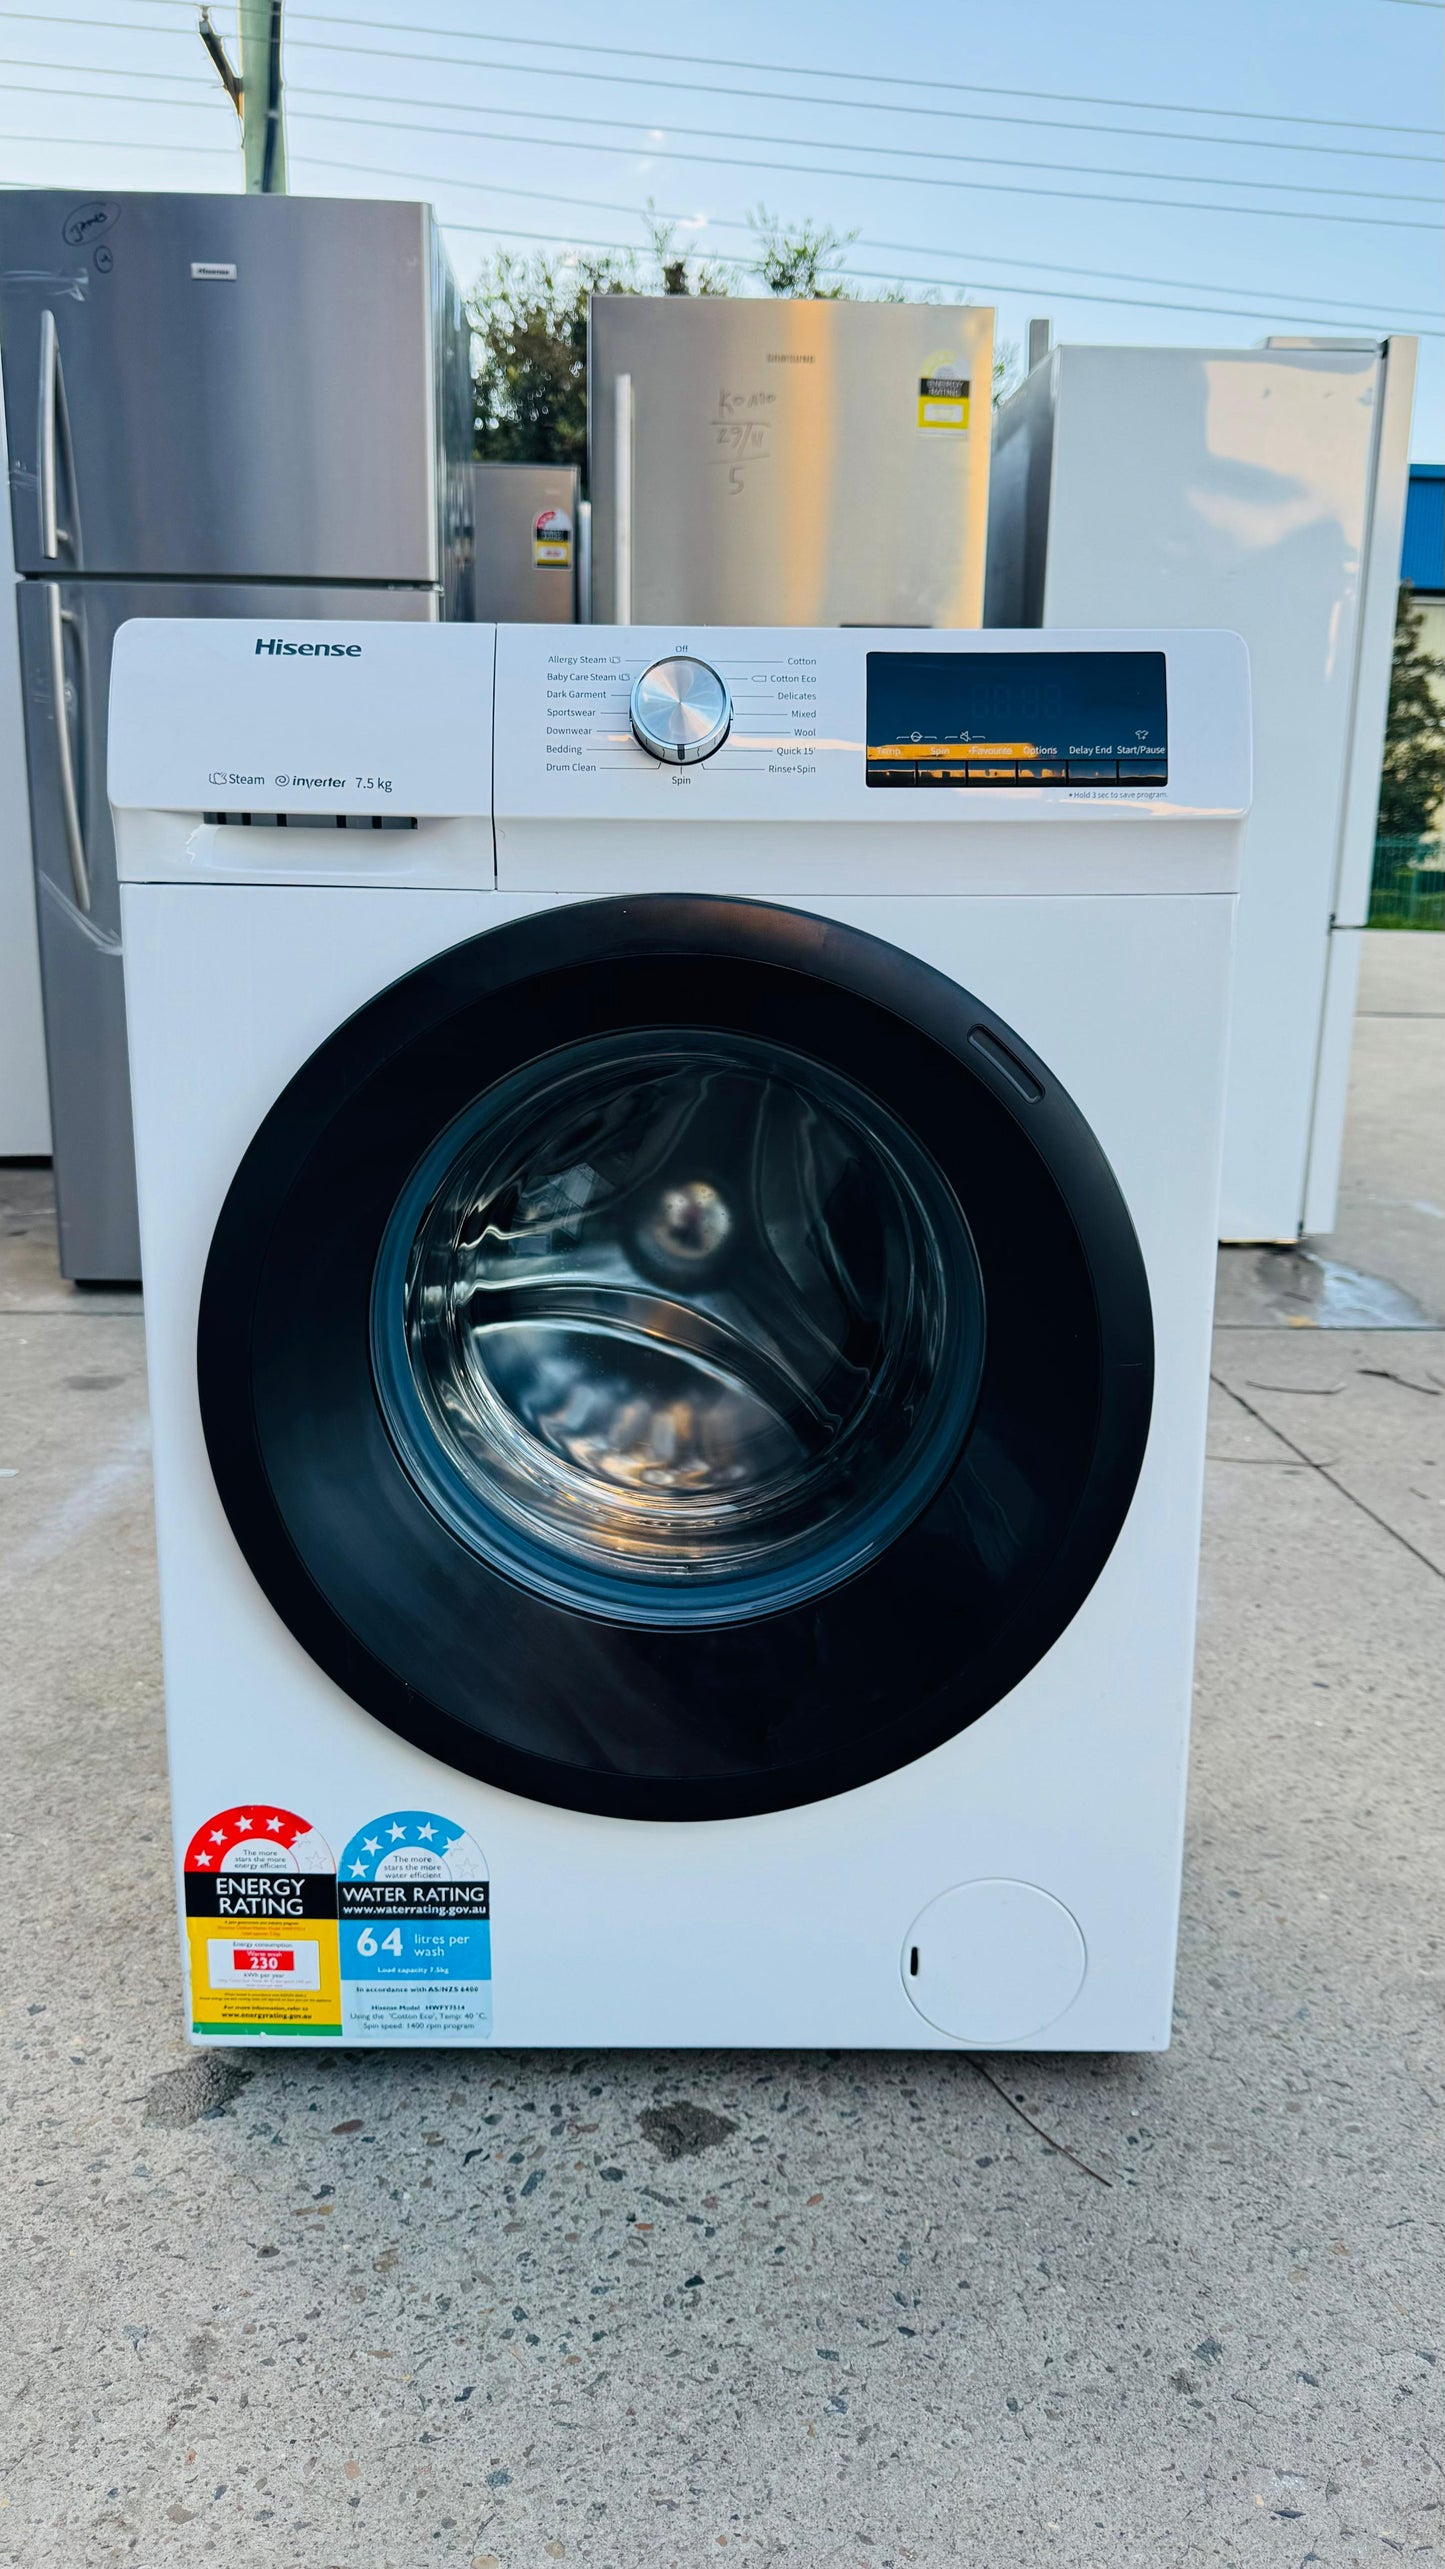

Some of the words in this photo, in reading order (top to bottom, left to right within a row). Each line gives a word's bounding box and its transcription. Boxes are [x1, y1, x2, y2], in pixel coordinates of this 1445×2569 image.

[729, 466, 745, 496] 5
[255, 638, 362, 657] Hisense
[675, 645, 689, 653] Off
[548, 656, 578, 665] Allergy
[580, 656, 607, 664] Steam
[787, 657, 817, 665] Cotton
[547, 673, 569, 682] Baby
[569, 673, 589, 681] Care
[590, 673, 617, 681] Steam
[770, 675, 799, 683] Cotton
[801, 675, 817, 683] Eco
[546, 690, 567, 698] Dark
[568, 690, 607, 699] Garment
[777, 692, 817, 700] Delicates
[547, 708, 596, 717] Sportswear
[791, 710, 817, 718] Mixed
[546, 726, 593, 735] Downwear
[794, 728, 816, 737] Wool
[546, 744, 583, 755] Bedding
[776, 746, 802, 756] Quick
[930, 747, 950, 757] Spin
[1023, 746, 1058, 757] Options
[1069, 745, 1094, 757] Delay
[1095, 745, 1112, 754] End
[1116, 745, 1166, 755] Start/Pause
[546, 763, 571, 772] Drum
[572, 763, 597, 772] Clean
[768, 764, 816, 775] Rinse+Spin
[228, 773, 265, 785] Steam
[292, 775, 346, 789] inverter
[355, 777, 375, 789] 7.5
[377, 777, 393, 793] kg
[671, 775, 691, 786] Spin
[393, 1855, 409, 1863] The
[216, 1877, 306, 1896] ENERGY
[343, 1887, 407, 1902] WATER
[413, 1887, 485, 1903] RATING
[219, 1897, 304, 1916] RATING
[343, 1904, 487, 1916] www.waterrating.gov.au
[233, 1941, 253, 1949] Energy
[356, 1927, 403, 1957] 64
[414, 1933, 445, 1945] litres
[449, 1935, 470, 1947] per
[413, 1946, 445, 1957] wash
[250, 1957, 279, 1970] 230
[221, 2012, 313, 2020] www.energyrating.gov.au
[350, 2013, 371, 2021] Using
[363, 2022, 380, 2031] Spin
[426, 2023, 442, 2031] rpm
[443, 2023, 475, 2031] program
